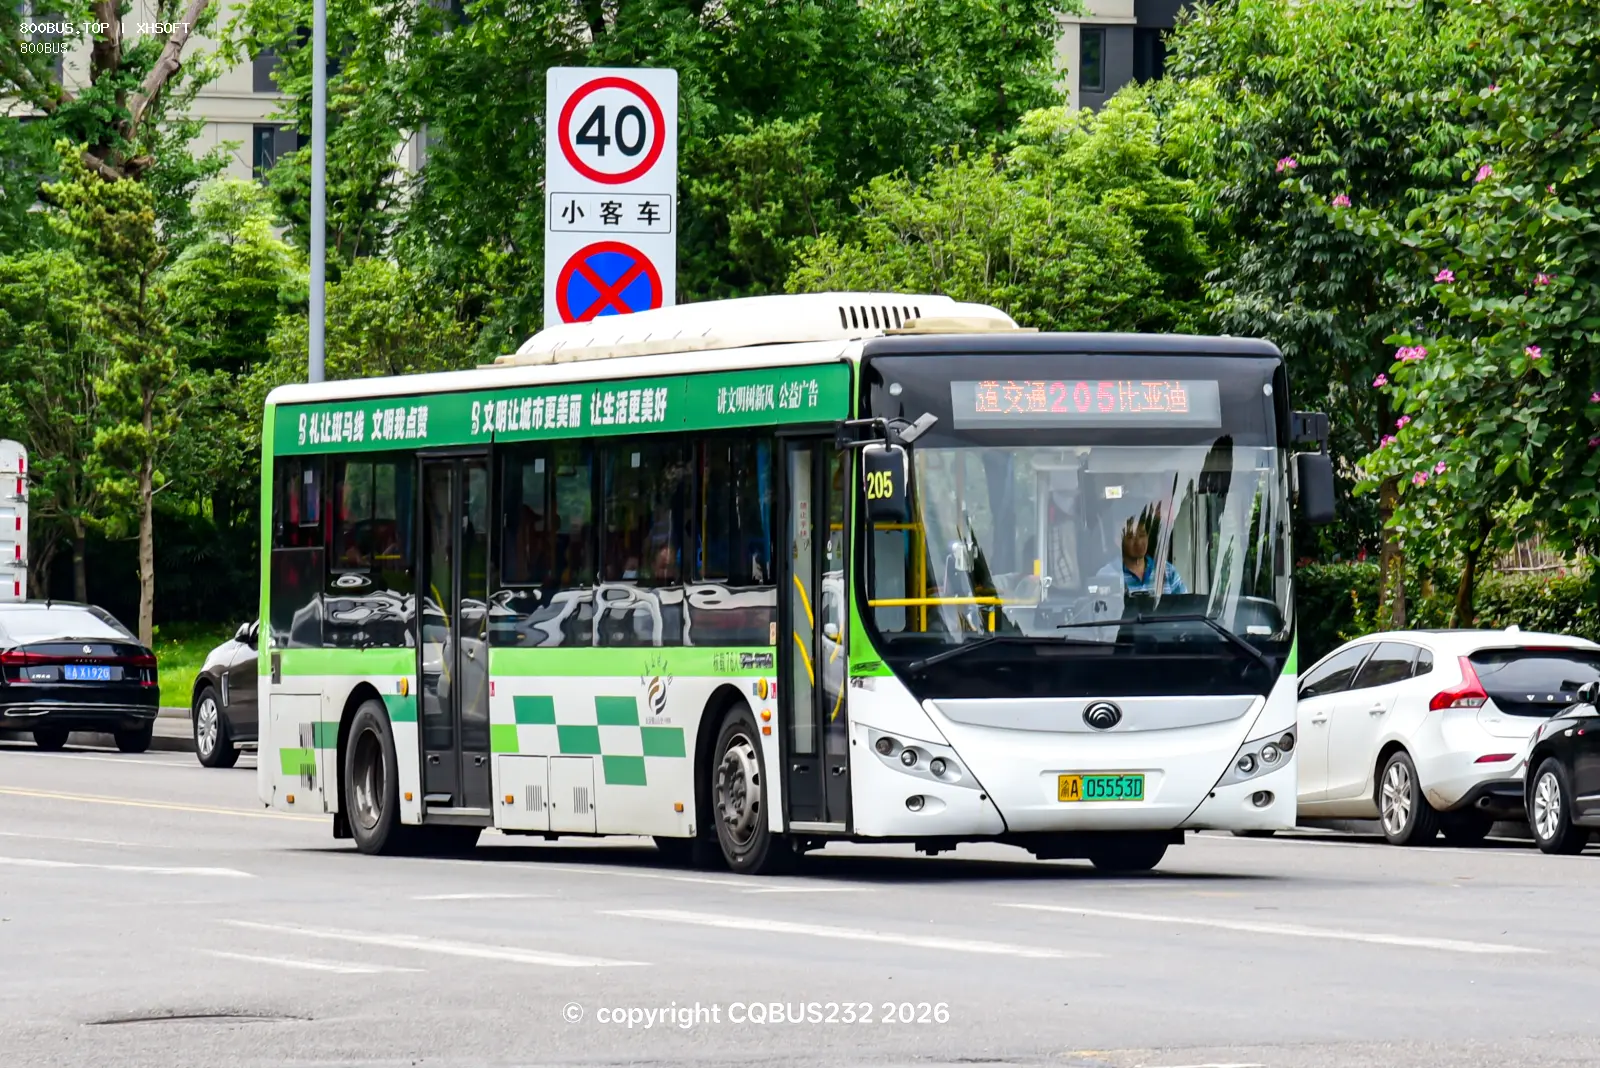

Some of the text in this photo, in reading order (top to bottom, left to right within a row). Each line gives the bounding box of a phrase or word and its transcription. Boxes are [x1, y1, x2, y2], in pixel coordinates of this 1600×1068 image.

[576, 105, 647, 157] 40
[561, 199, 661, 226] 小客车
[482, 387, 668, 433] 文明让城市更美丽 让生活更美好
[717, 379, 818, 414] 讲文明树新风 公益广告
[309, 405, 429, 445] 礼让斑马线 文明我点赞
[866, 470, 894, 500] 205
